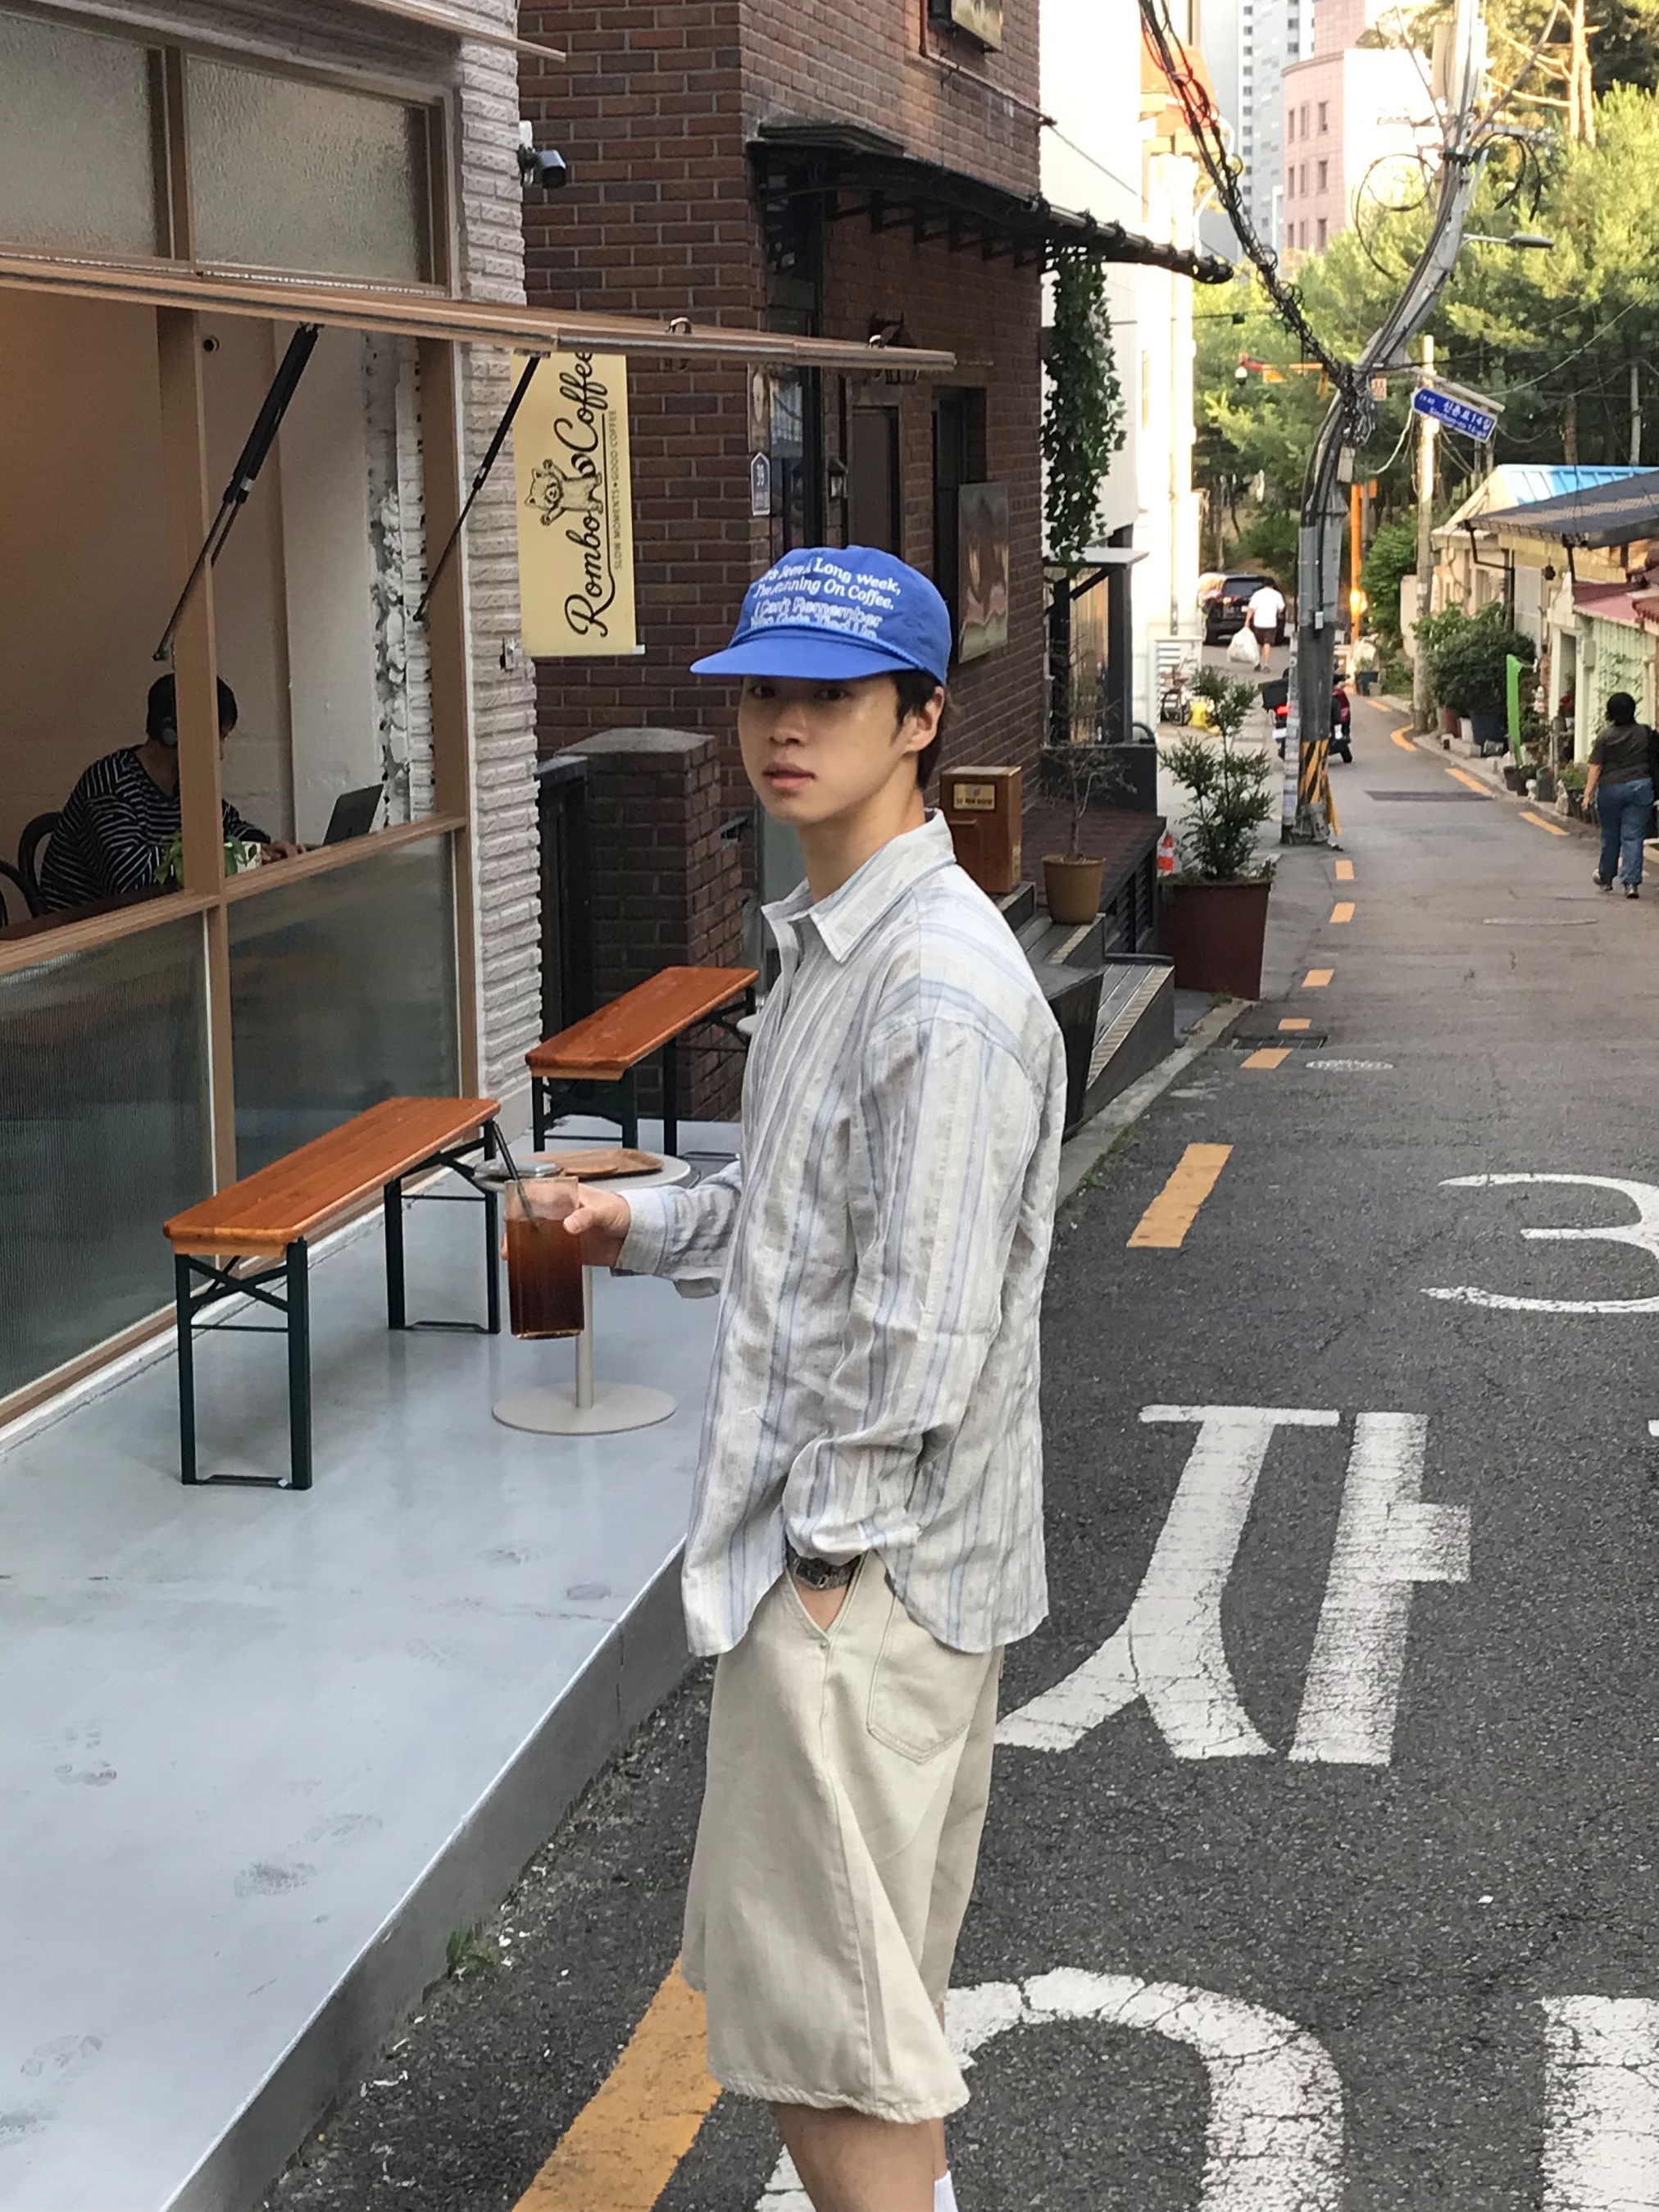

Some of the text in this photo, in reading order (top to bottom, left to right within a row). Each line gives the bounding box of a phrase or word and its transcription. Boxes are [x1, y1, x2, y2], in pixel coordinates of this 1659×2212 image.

[608, 411, 622, 571] SLOW MOMENTS GOOD COFFEE
[564, 511, 615, 638] Rombo
[813, 557, 852, 585] Long
[823, 578, 846, 598] On
[848, 585, 894, 611] Coffee.
